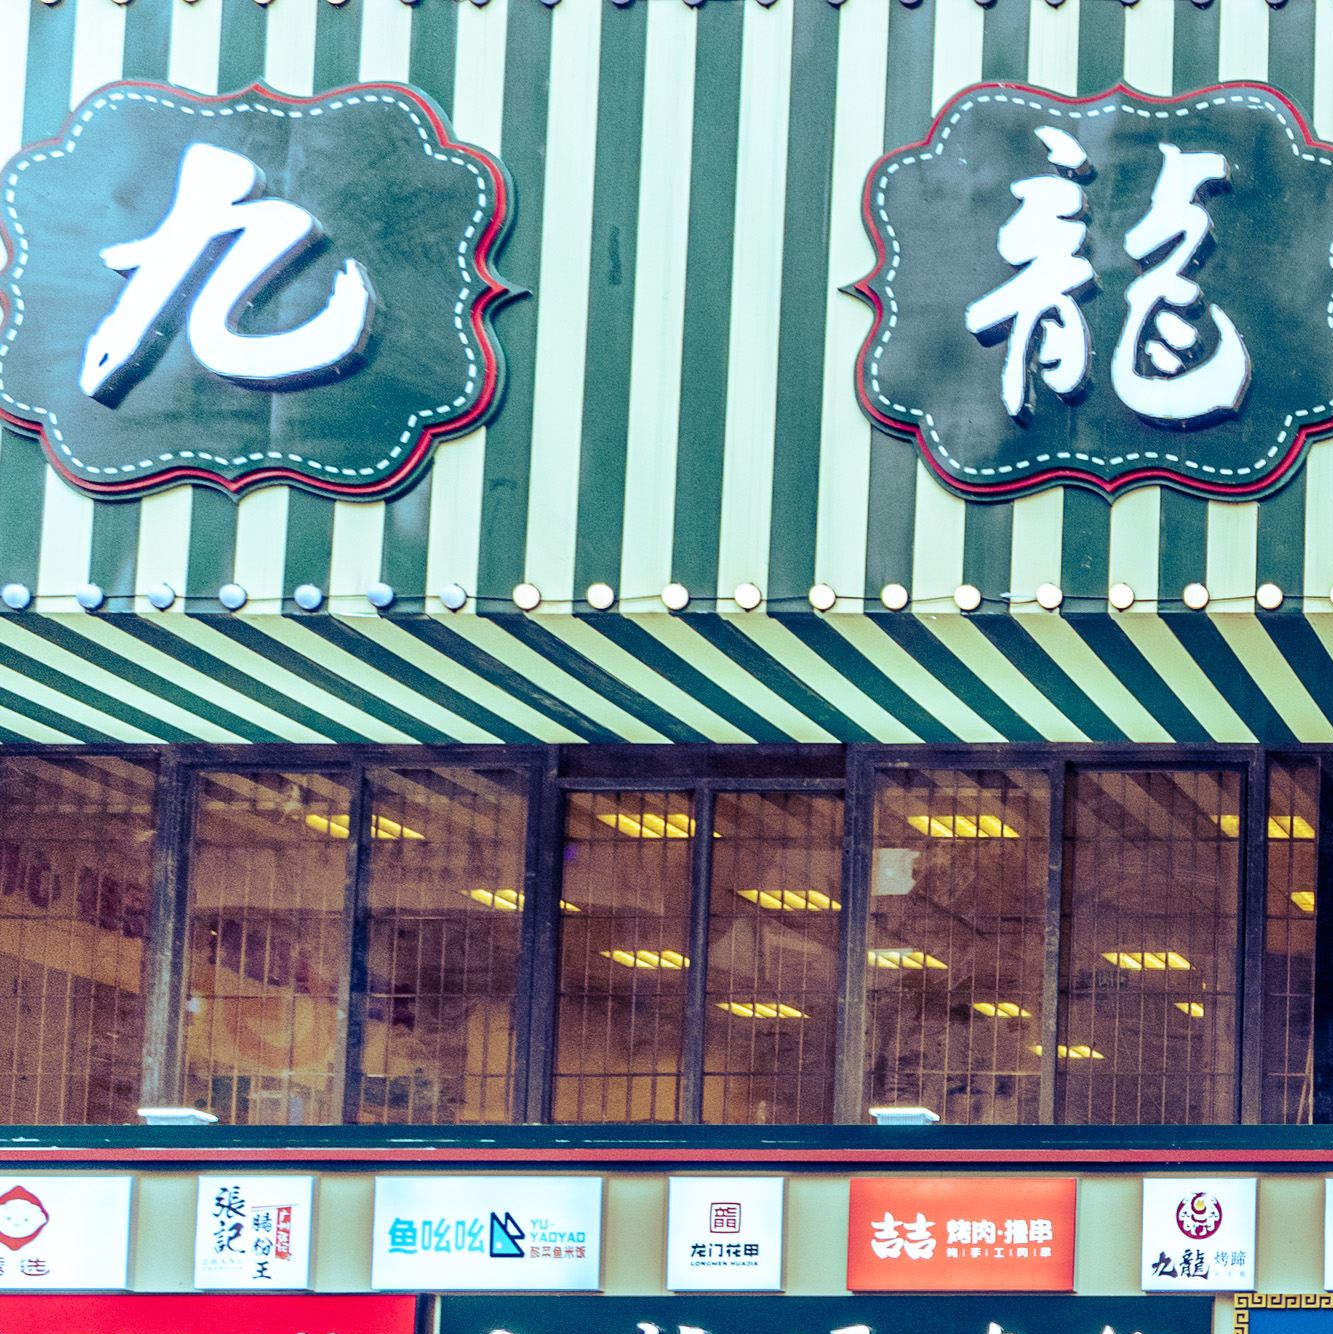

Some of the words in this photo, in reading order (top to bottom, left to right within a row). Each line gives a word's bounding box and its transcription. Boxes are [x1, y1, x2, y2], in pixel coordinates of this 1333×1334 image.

[388, 1216, 486, 1255] 鱼吆吆
[530, 1231, 586, 1244] YAOYAO
[690, 1243, 760, 1259] 龙门花甲
